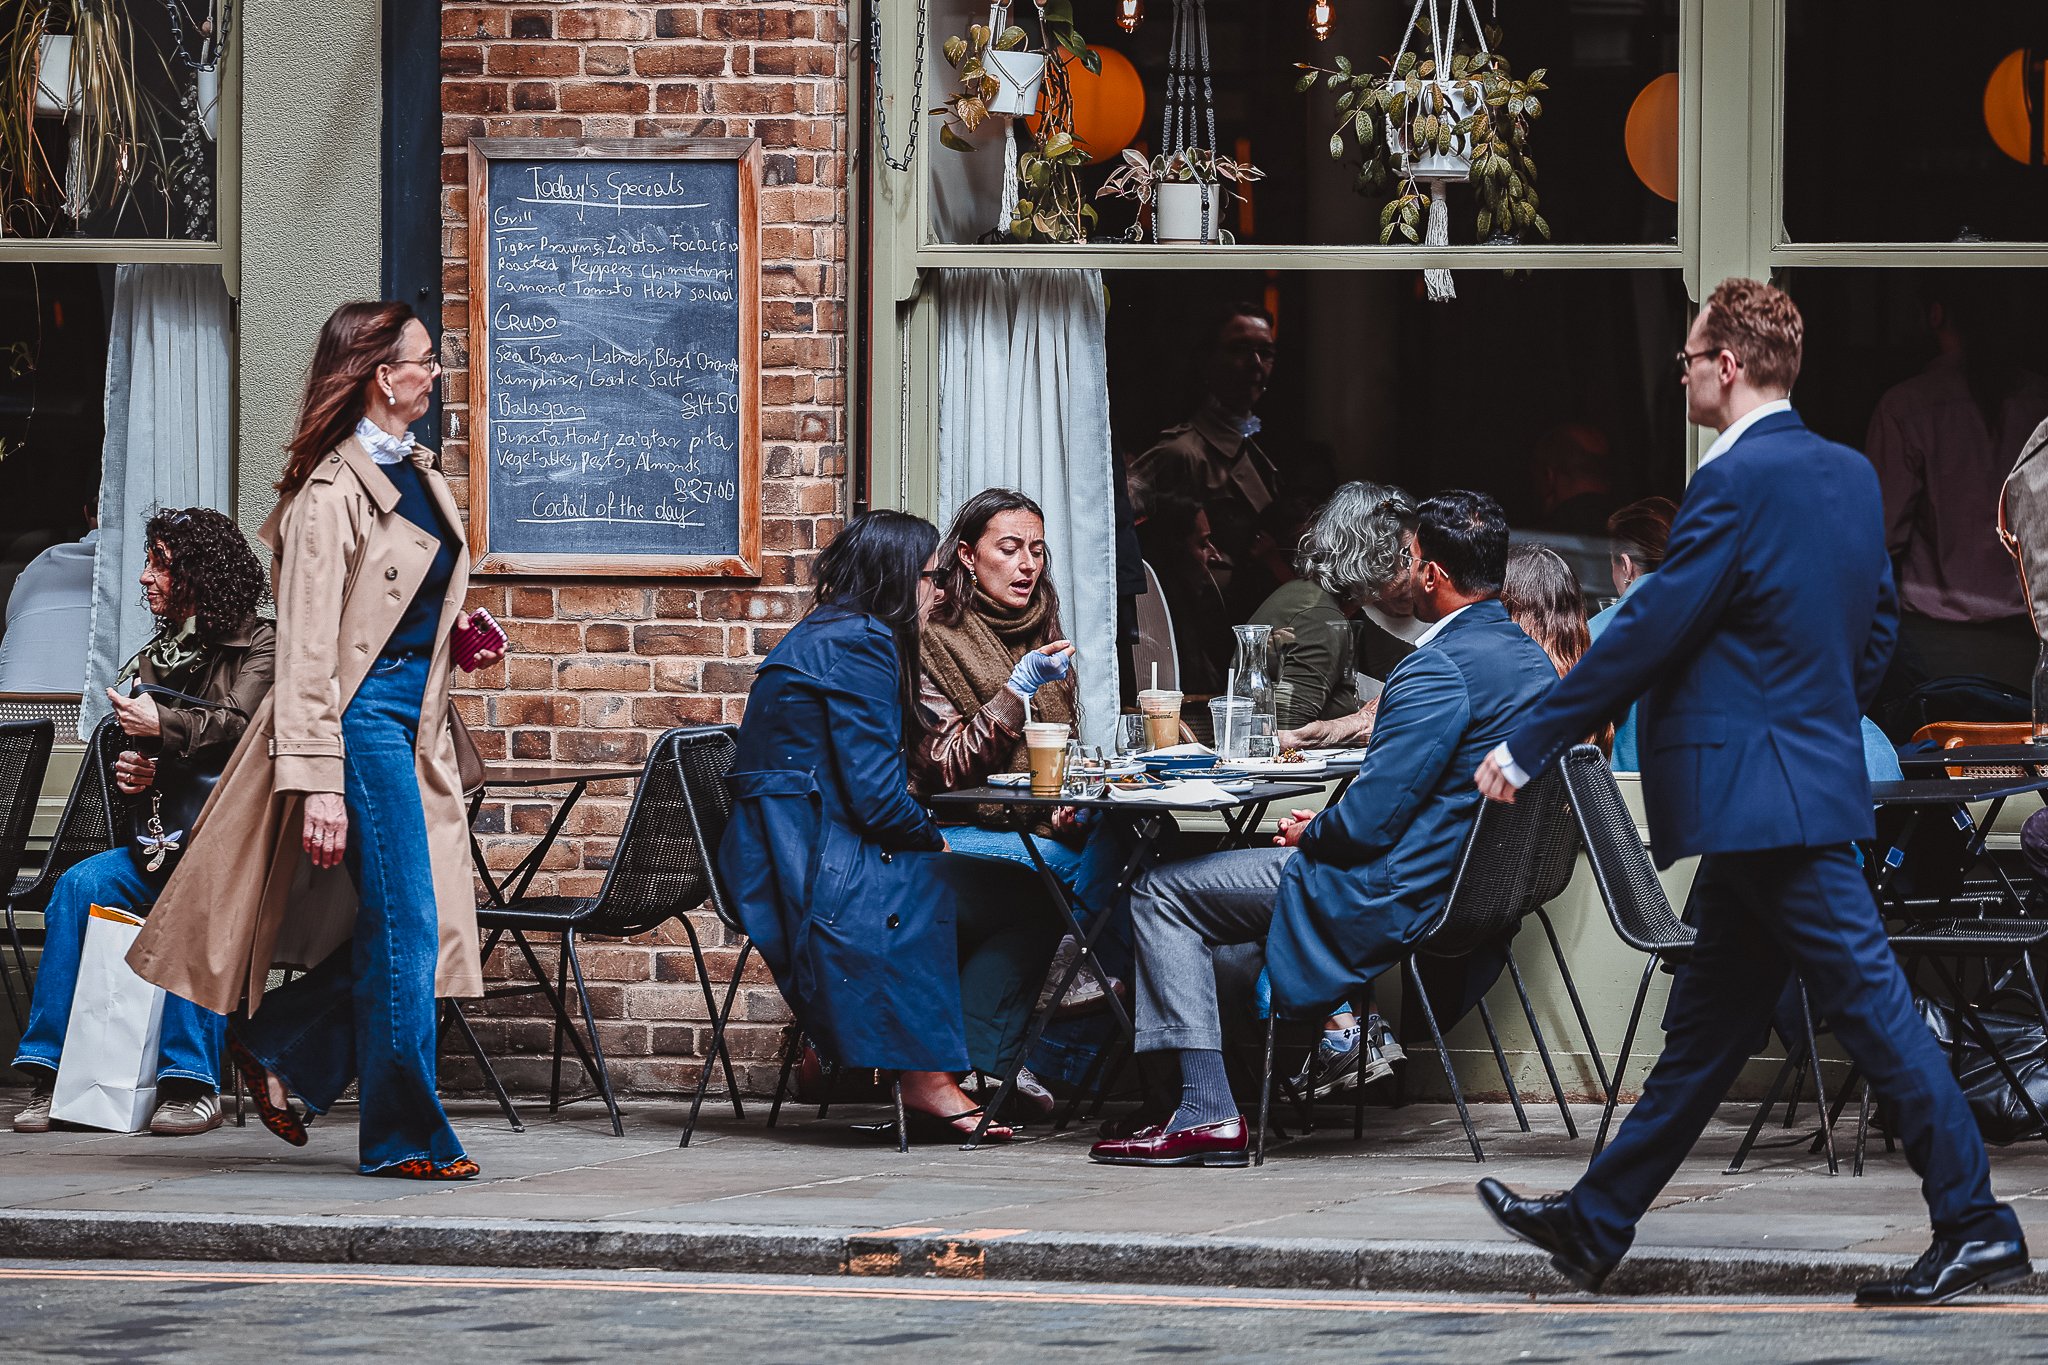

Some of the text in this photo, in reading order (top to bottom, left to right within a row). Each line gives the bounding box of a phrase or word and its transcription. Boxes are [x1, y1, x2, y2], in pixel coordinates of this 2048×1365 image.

[526, 167, 684, 221] Today's Specials
[494, 206, 532, 226] Grill
[496, 237, 535, 256] Tiger
[669, 234, 738, 253] Focaccia
[498, 255, 559, 272] Roasted
[572, 255, 632, 282] Peppers
[574, 277, 632, 297] Tomato
[644, 281, 681, 298] Herb
[496, 345, 525, 363] Sea
[655, 348, 690, 369] Blood
[590, 369, 639, 387] Garlic
[648, 370, 684, 387] Salt
[498, 393, 586, 426] Balagan
[497, 447, 577, 474] Vegetables,
[635, 452, 701, 475] Almonds
[674, 478, 735, 503] £27.00
[596, 491, 615, 524] of
[620, 496, 643, 516] the
[655, 497, 696, 528] day
